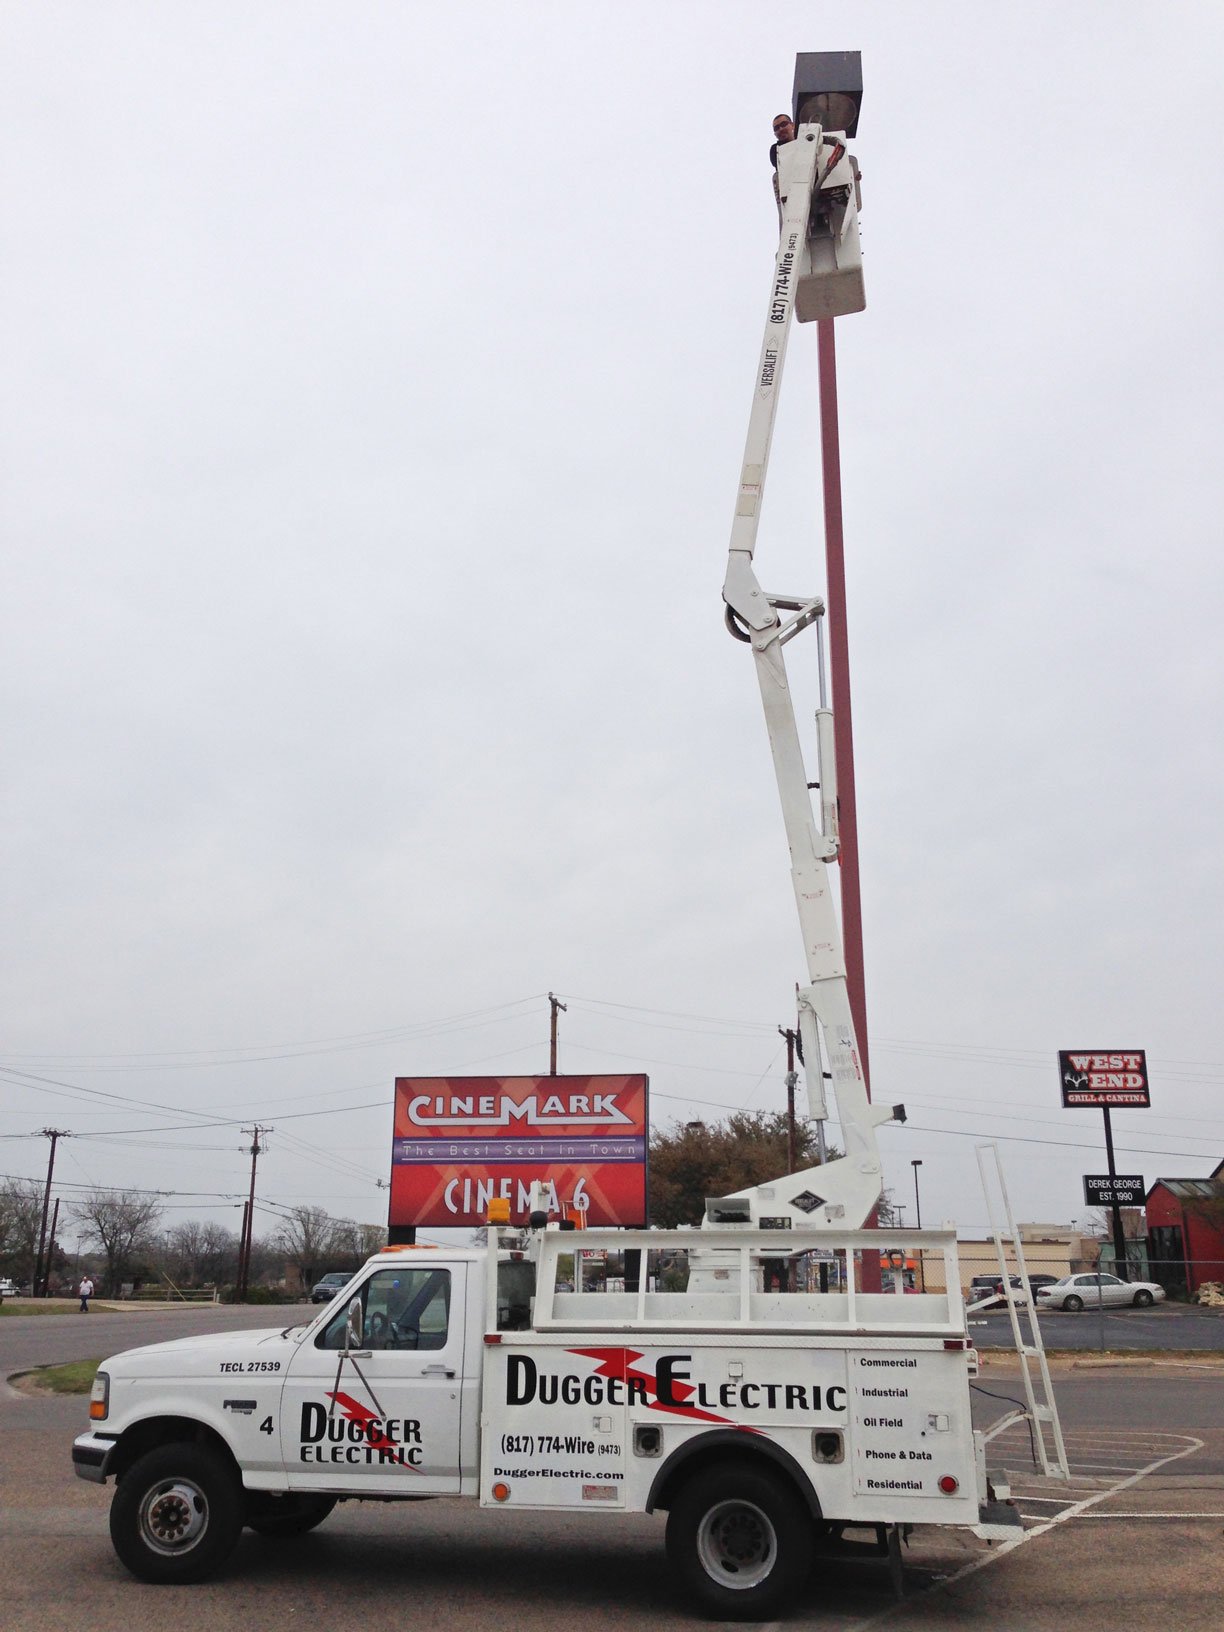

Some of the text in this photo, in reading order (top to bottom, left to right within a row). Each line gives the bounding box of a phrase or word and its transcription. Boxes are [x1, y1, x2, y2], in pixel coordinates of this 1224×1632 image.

[770, 232, 798, 324] (817) 774-Wire (9473)
[761, 349, 778, 387] VERSALIFT
[1069, 1054, 1142, 1071] WEST
[1089, 1072, 1144, 1089] END
[1068, 1093, 1147, 1103] GRILL & CANTINA
[407, 1094, 636, 1126] CINEMARK
[403, 1143, 636, 1156] The Best Seat In Town
[1088, 1179, 1142, 1188] DEREK GEORGE
[572, 1176, 590, 1211] 6
[1100, 1192, 1133, 1201] EST. 1990
[219, 1362, 281, 1373] TECL 27539
[860, 1358, 917, 1368] Commercial
[506, 1355, 847, 1412] DUGGER ELECTRIC
[862, 1388, 908, 1398] Industrial
[259, 1416, 274, 1435] 4
[300, 1401, 423, 1444] DUGGER
[864, 1418, 903, 1427] Oil Field
[501, 1434, 621, 1456] (817) 774-Wire (9473)
[300, 1446, 423, 1465] ELECTRIC
[866, 1450, 932, 1460] Phone & Data
[494, 1468, 624, 1480] DuggerElectric.com
[867, 1480, 922, 1490] Residential
